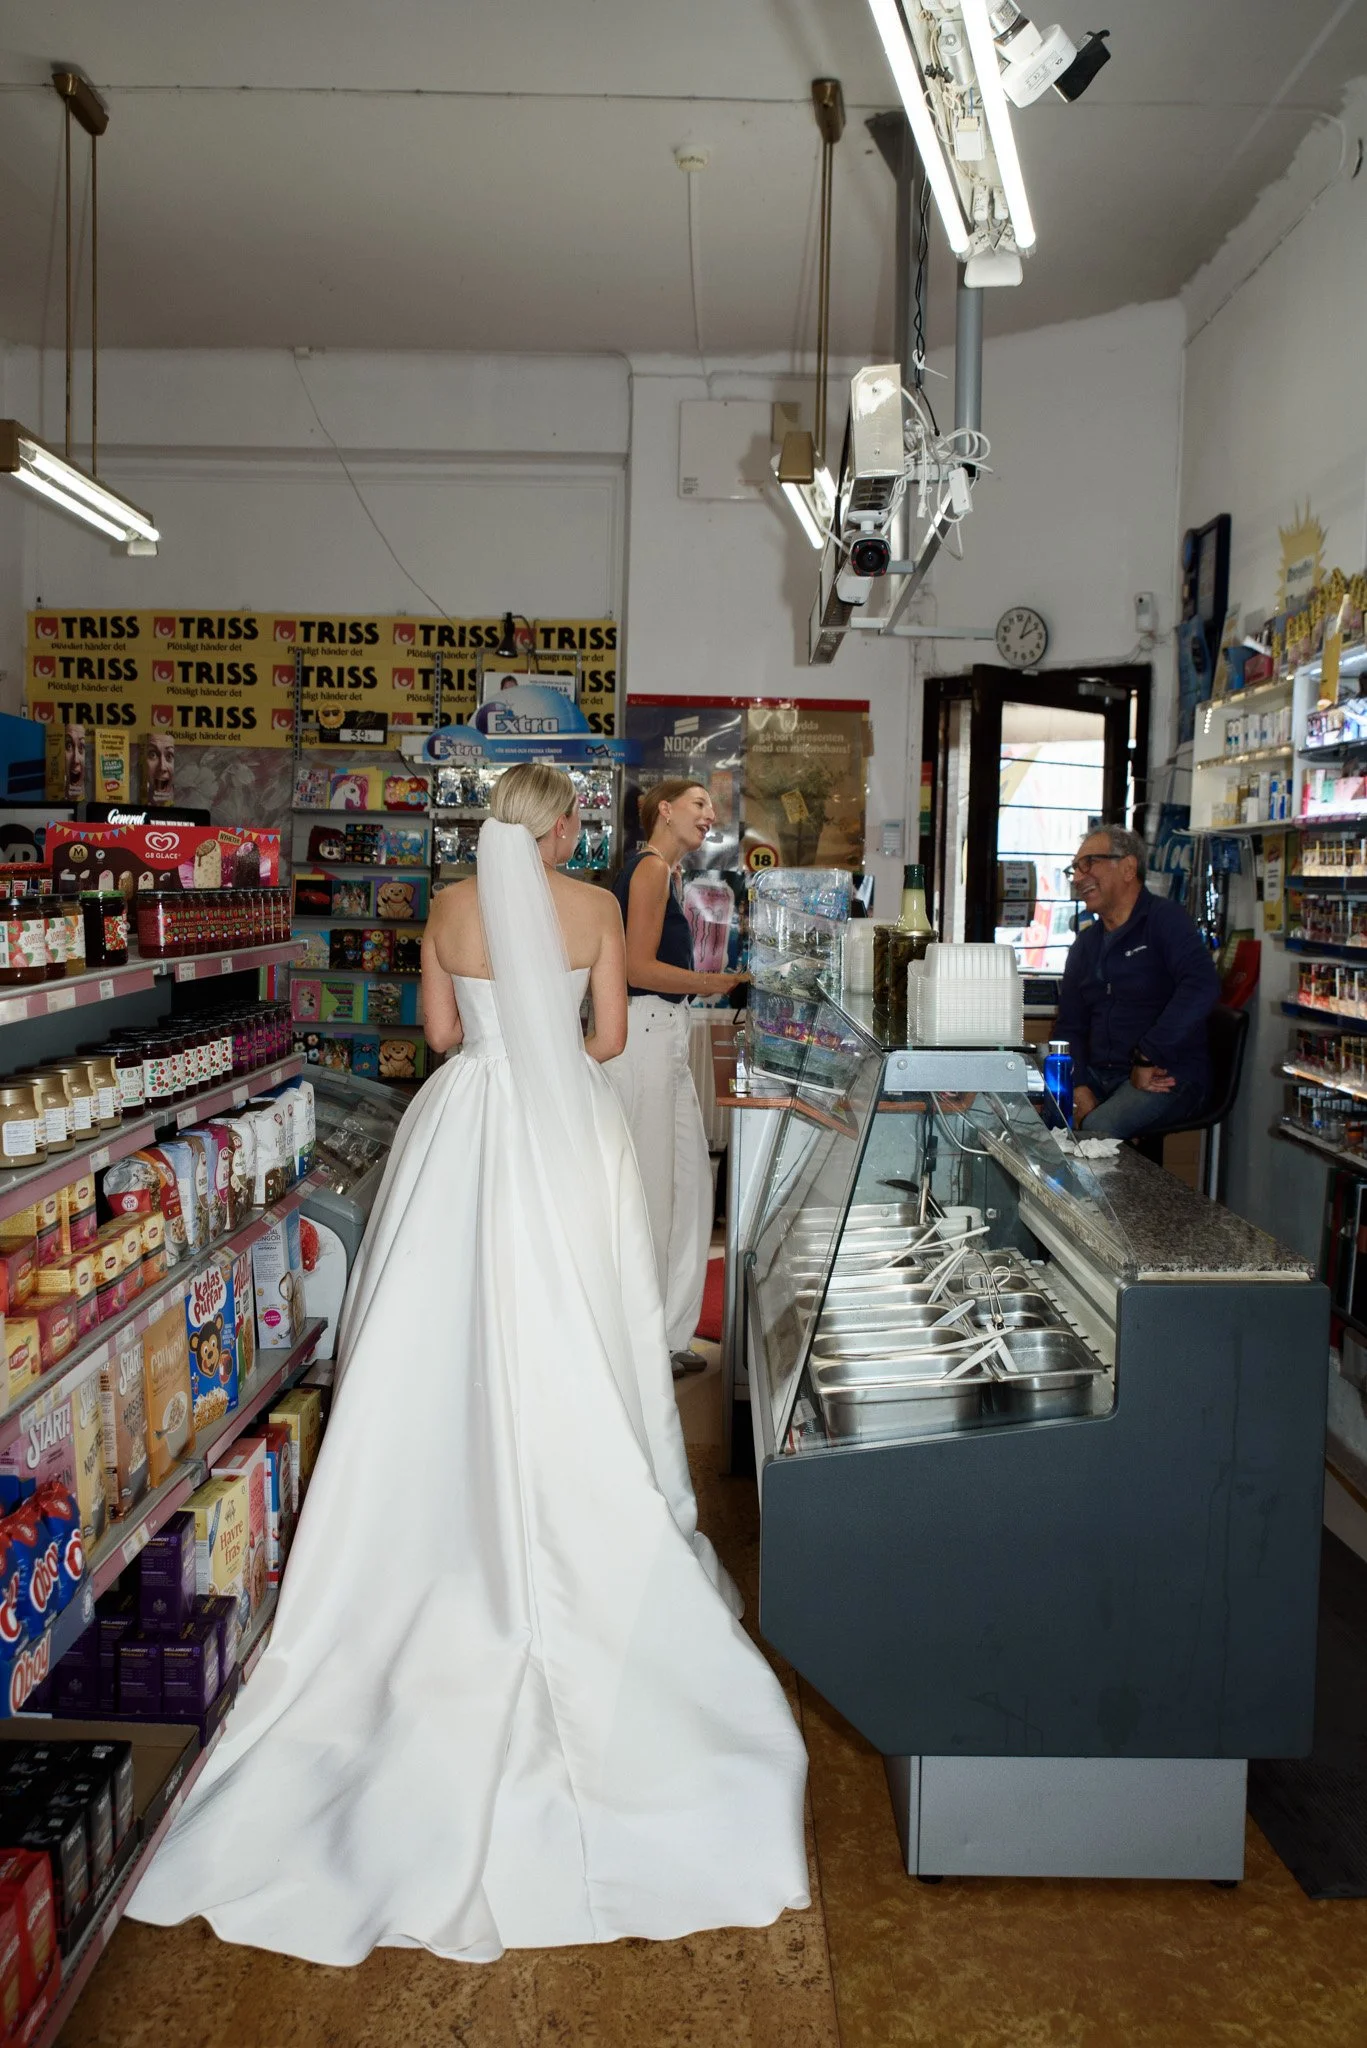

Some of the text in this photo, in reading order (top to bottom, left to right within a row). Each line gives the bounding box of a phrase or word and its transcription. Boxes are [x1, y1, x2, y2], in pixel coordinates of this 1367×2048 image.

[61, 616, 140, 640] TRISS
[179, 617, 259, 640] TRISS
[300, 621, 380, 645] TRISS
[419, 625, 500, 648] TRISS
[85, 642, 110, 651] händer
[113, 642, 126, 651] det
[167, 641, 242, 652] Plötsligt händer det
[540, 627, 616, 650] TRISS
[287, 645, 363, 657] Plsligt händer det
[407, 649, 438, 660] Plötslig
[591, 653, 604, 662] det
[58, 655, 138, 682] TRISS
[178, 661, 258, 687] TRISS
[301, 666, 378, 689] TRISS
[47, 682, 123, 694] Plötsligt händer det
[166, 686, 242, 697] Plötsligt händer det
[287, 690, 362, 701] Plsligt händer det
[590, 697, 604, 706] det
[57, 702, 136, 726] TRISS
[177, 705, 257, 730] TRISS
[487, 709, 559, 735] Extra
[200, 730, 227, 741] händer
[228, 731, 241, 742] det
[664, 736, 707, 752] NOCCO
[433, 738, 483, 757] Extra
[145, 852, 178, 860] GB GLACE
[754, 854, 771, 866] 18
[27, 1402, 71, 1469] START!
[220, 1520, 244, 1551] Havre
[225, 1545, 241, 1565] fras
